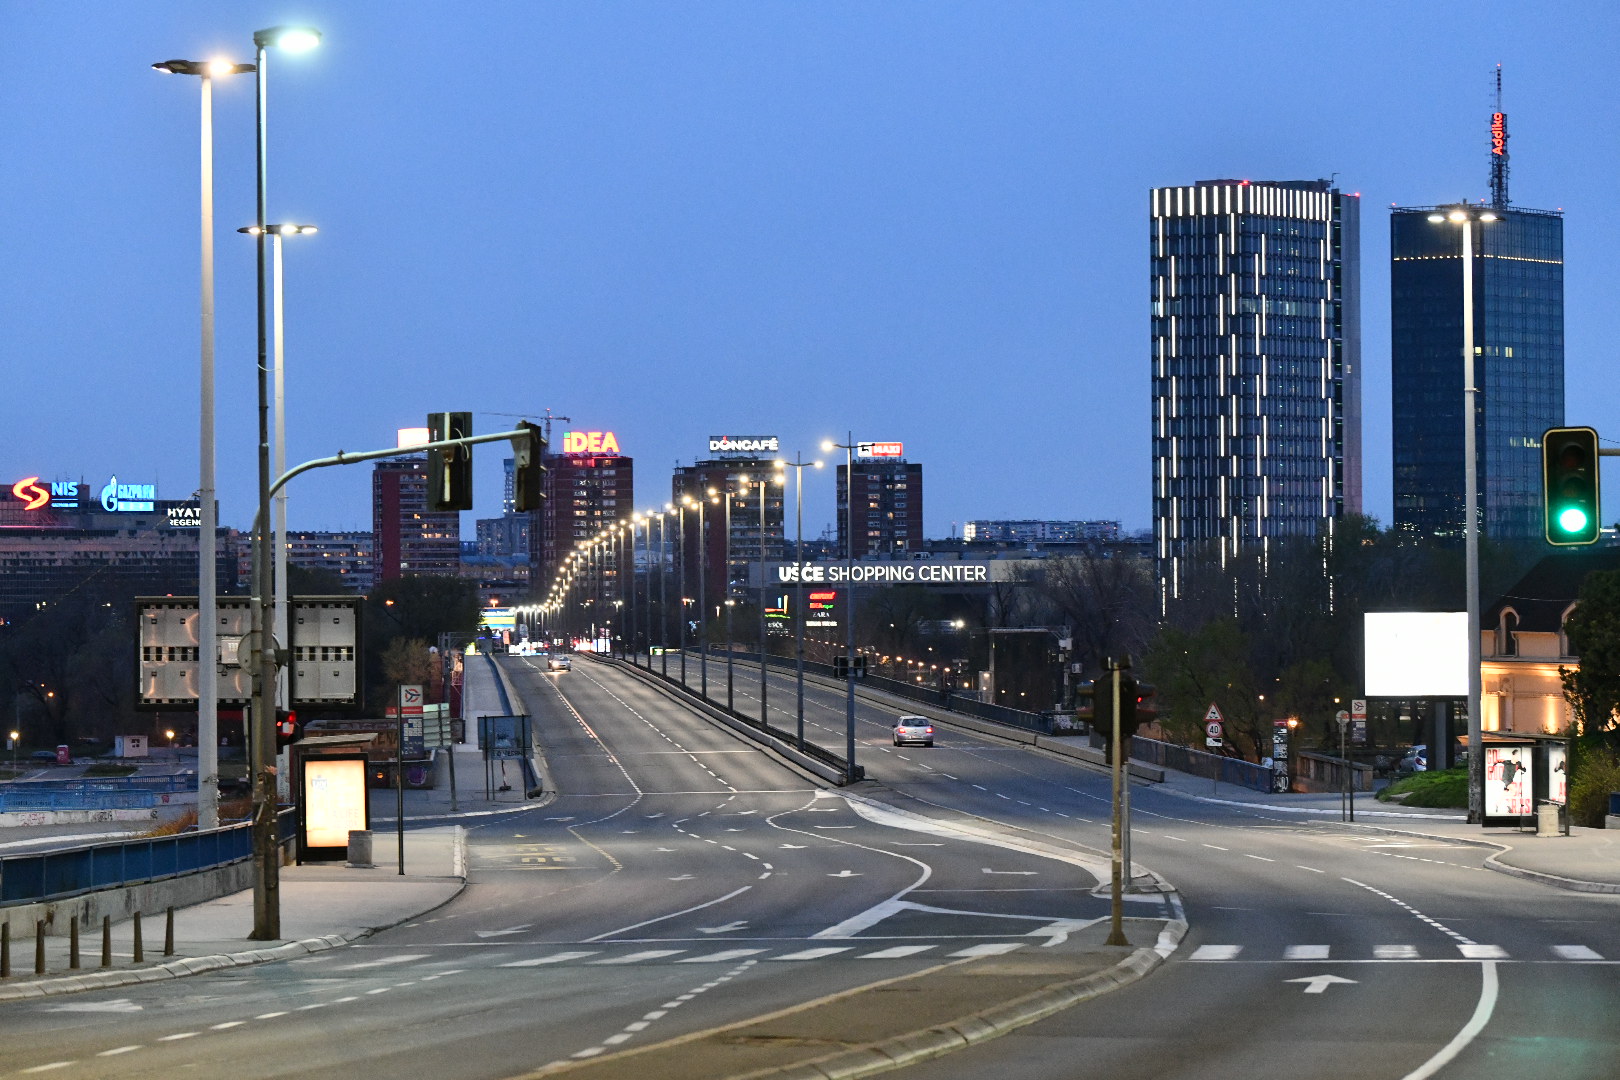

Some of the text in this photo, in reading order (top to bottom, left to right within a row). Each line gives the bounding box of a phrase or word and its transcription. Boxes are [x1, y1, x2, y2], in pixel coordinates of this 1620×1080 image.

[1491, 112, 1504, 155] Addiko
[563, 431, 620, 453] iDEA
[709, 437, 778, 451] DONCAFÉ
[51, 481, 79, 496] NIS
[167, 507, 202, 518] HYAT
[778, 561, 987, 582] UŠĆE SHOPPING CENTER
[1209, 725, 1219, 735] 40
